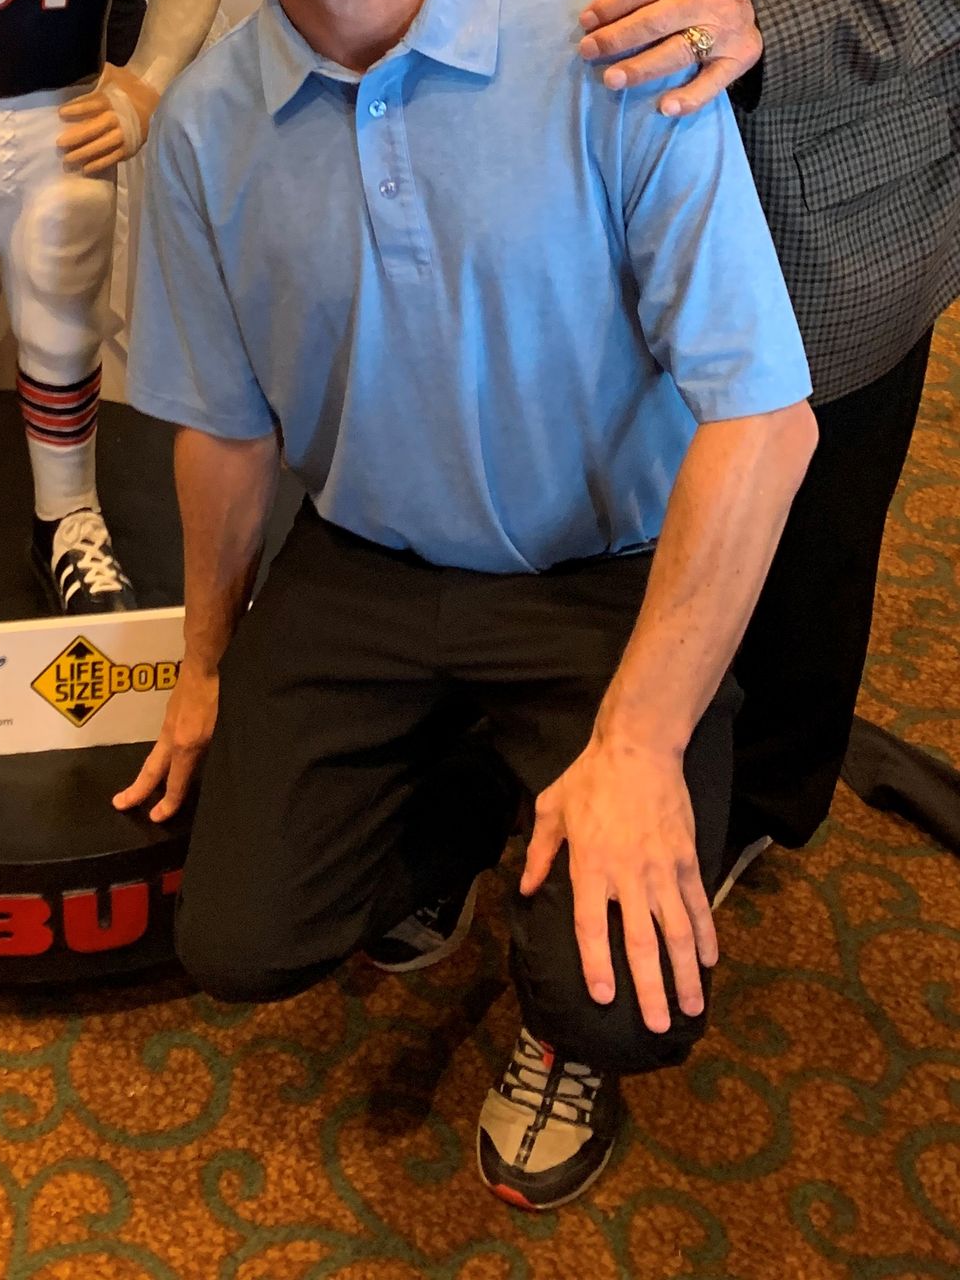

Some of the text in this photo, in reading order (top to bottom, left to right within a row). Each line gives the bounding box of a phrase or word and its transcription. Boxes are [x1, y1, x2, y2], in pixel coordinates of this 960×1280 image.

[55, 660, 105, 683] LIFE
[109, 660, 183, 694] BOB
[55, 680, 104, 703] SIZE
